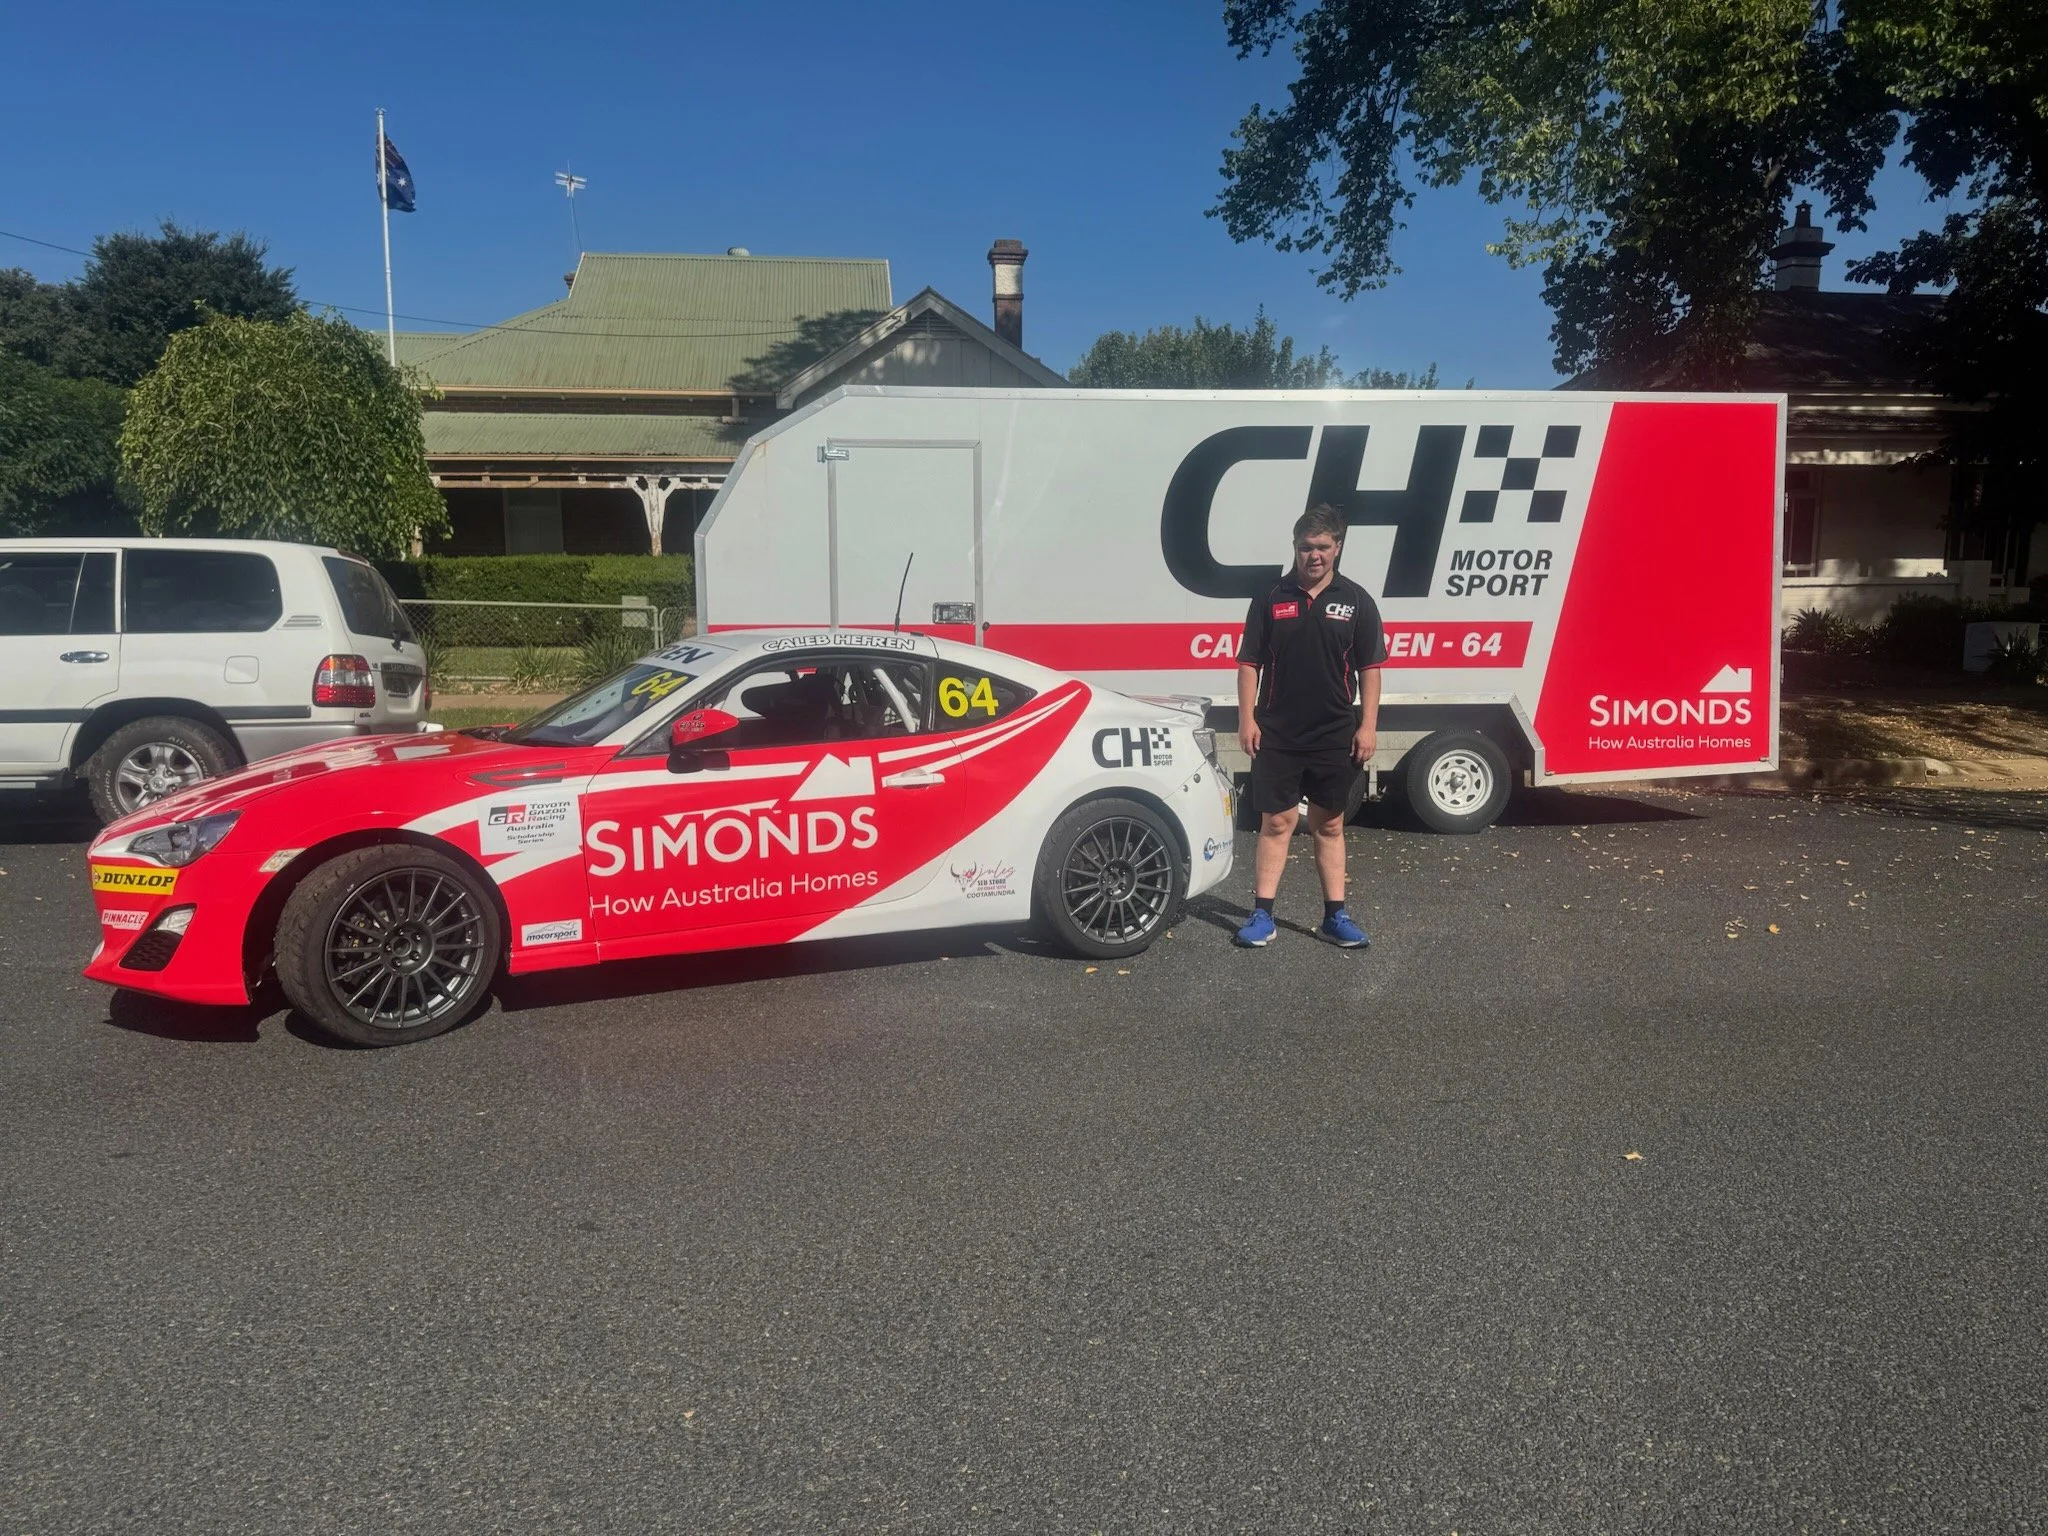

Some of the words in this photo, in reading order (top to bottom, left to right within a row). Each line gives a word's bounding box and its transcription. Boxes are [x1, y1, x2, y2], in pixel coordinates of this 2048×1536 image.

[1160, 425, 1467, 598] CH
[1450, 549, 1553, 571] MOTOR
[1445, 574, 1549, 597] SPORT
[1325, 602, 1347, 617] CH
[762, 634, 830, 651] CALEB
[834, 634, 914, 650] HEFREN
[1190, 633, 1244, 658] CA
[1383, 632, 1436, 657] EN
[1461, 632, 1503, 657] 64
[631, 671, 689, 700] 64
[938, 677, 999, 718] 64
[1092, 727, 1152, 769] CH
[1588, 736, 1623, 750] How
[1626, 735, 1694, 750] Australia
[1698, 735, 1752, 749] Homes
[529, 801, 571, 810] TOYOTA
[529, 807, 566, 816] GAZOO
[489, 811, 525, 825] GR
[528, 814, 565, 822] Racing
[506, 822, 554, 832] Australia
[507, 832, 555, 841] Scholarship
[102, 872, 174, 887] DUNLOP
[589, 895, 654, 917] How
[660, 878, 783, 910] Australia
[790, 870, 878, 895] Homes
[966, 889, 1016, 899] COOTAMUNDRA
[103, 912, 146, 924] PINNACLE
[526, 929, 578, 942] motorsport
